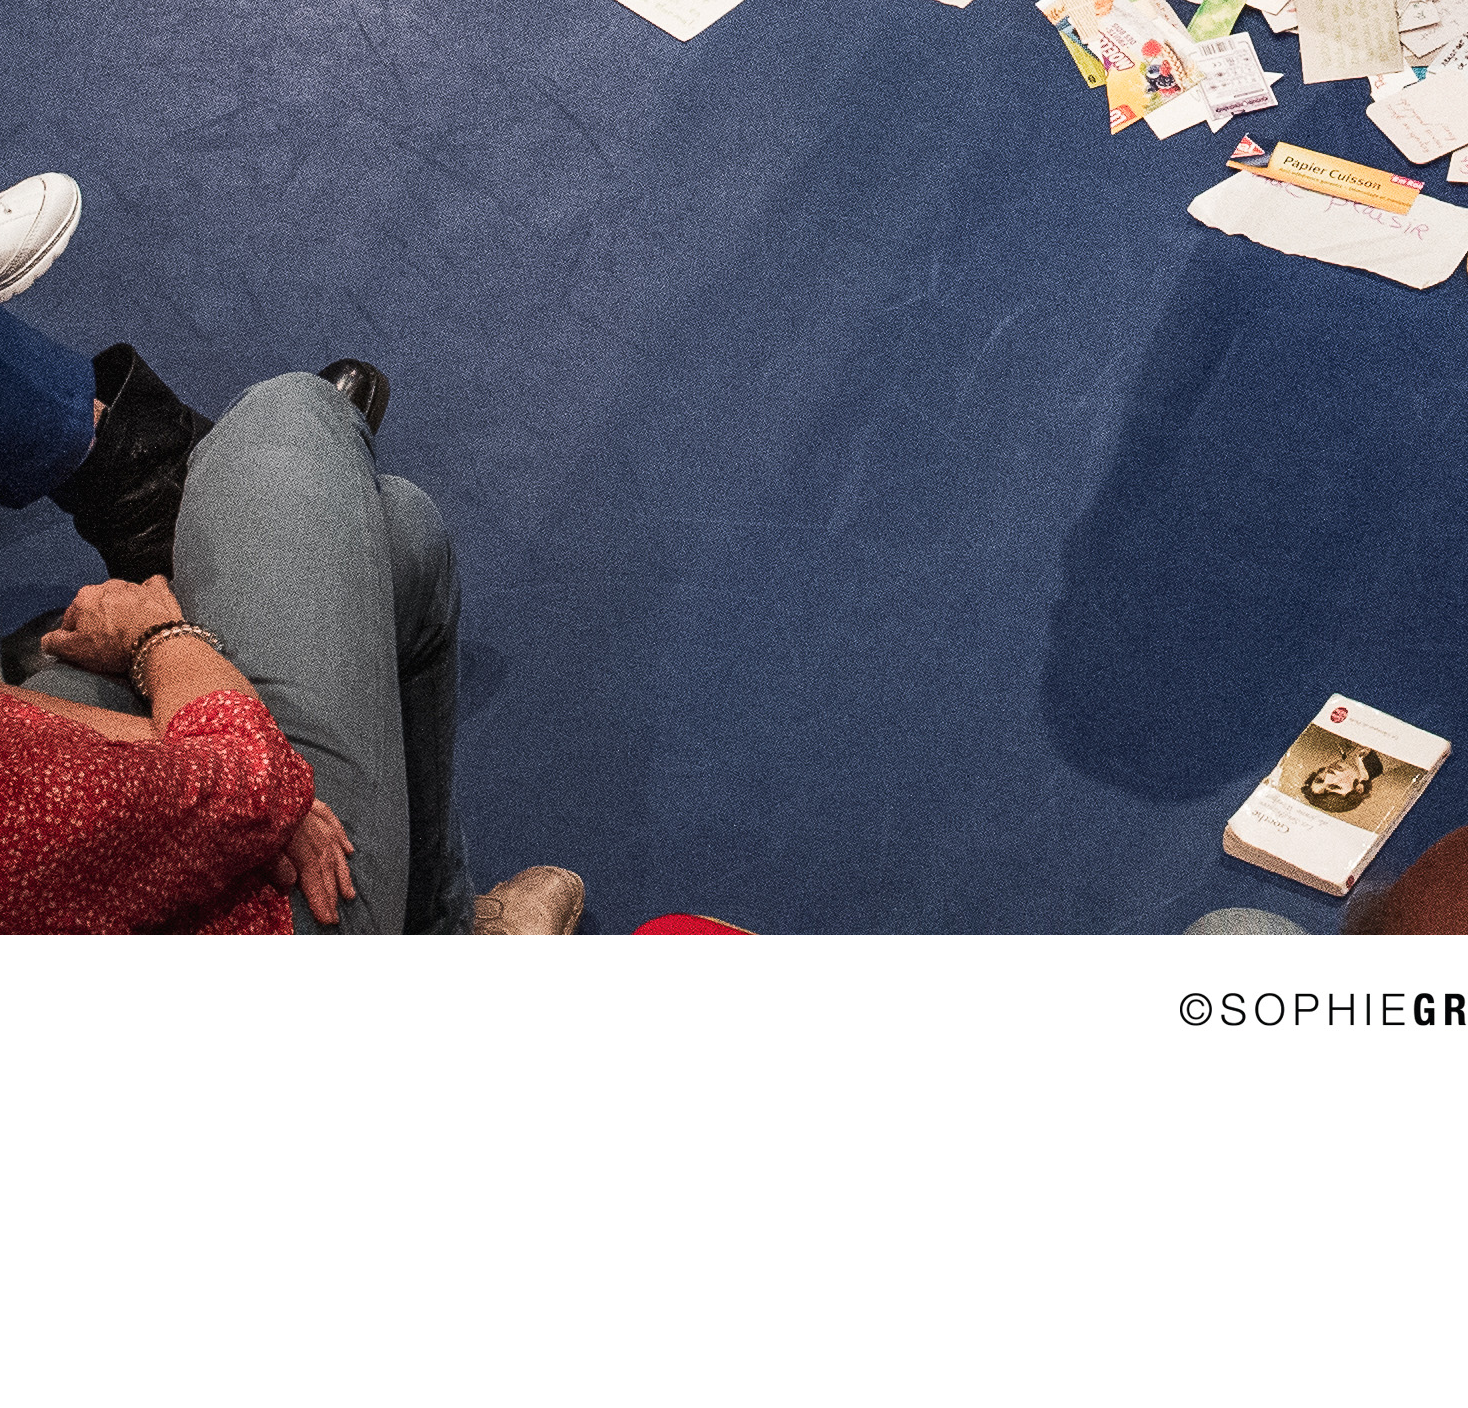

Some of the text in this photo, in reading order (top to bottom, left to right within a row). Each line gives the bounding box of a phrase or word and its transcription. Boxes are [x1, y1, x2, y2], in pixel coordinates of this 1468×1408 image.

[1282, 155, 1326, 175] Papier
[1327, 169, 1382, 191] Cuisson
[1251, 809, 1291, 834] Goethe
